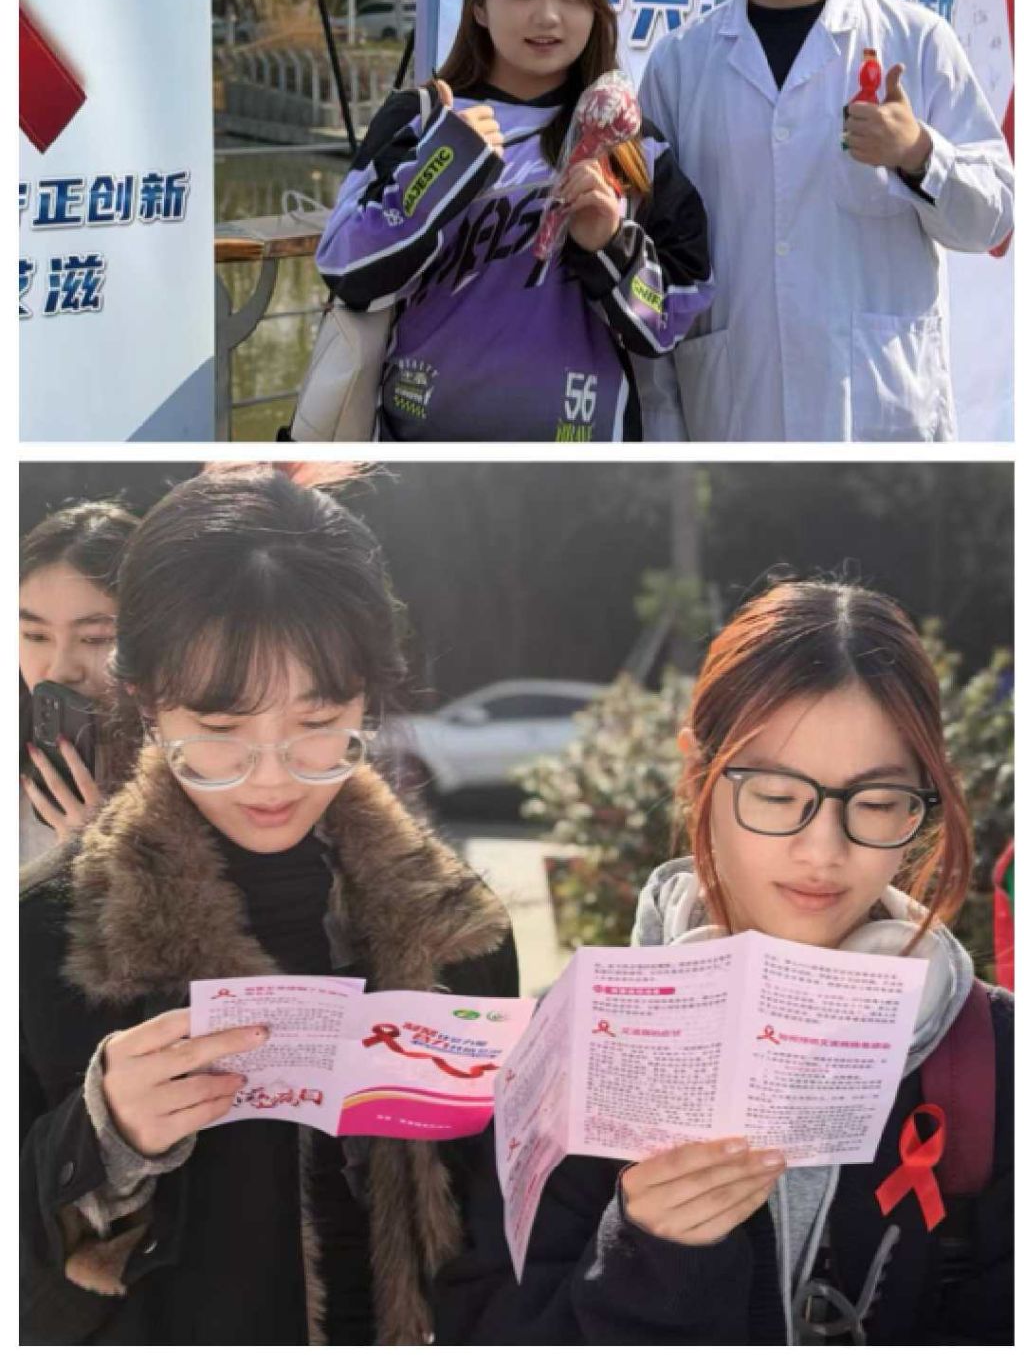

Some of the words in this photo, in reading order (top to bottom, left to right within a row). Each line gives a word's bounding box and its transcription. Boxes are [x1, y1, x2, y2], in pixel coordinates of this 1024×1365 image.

[19, 172, 187, 227] 正创新
[565, 371, 598, 422] 56
